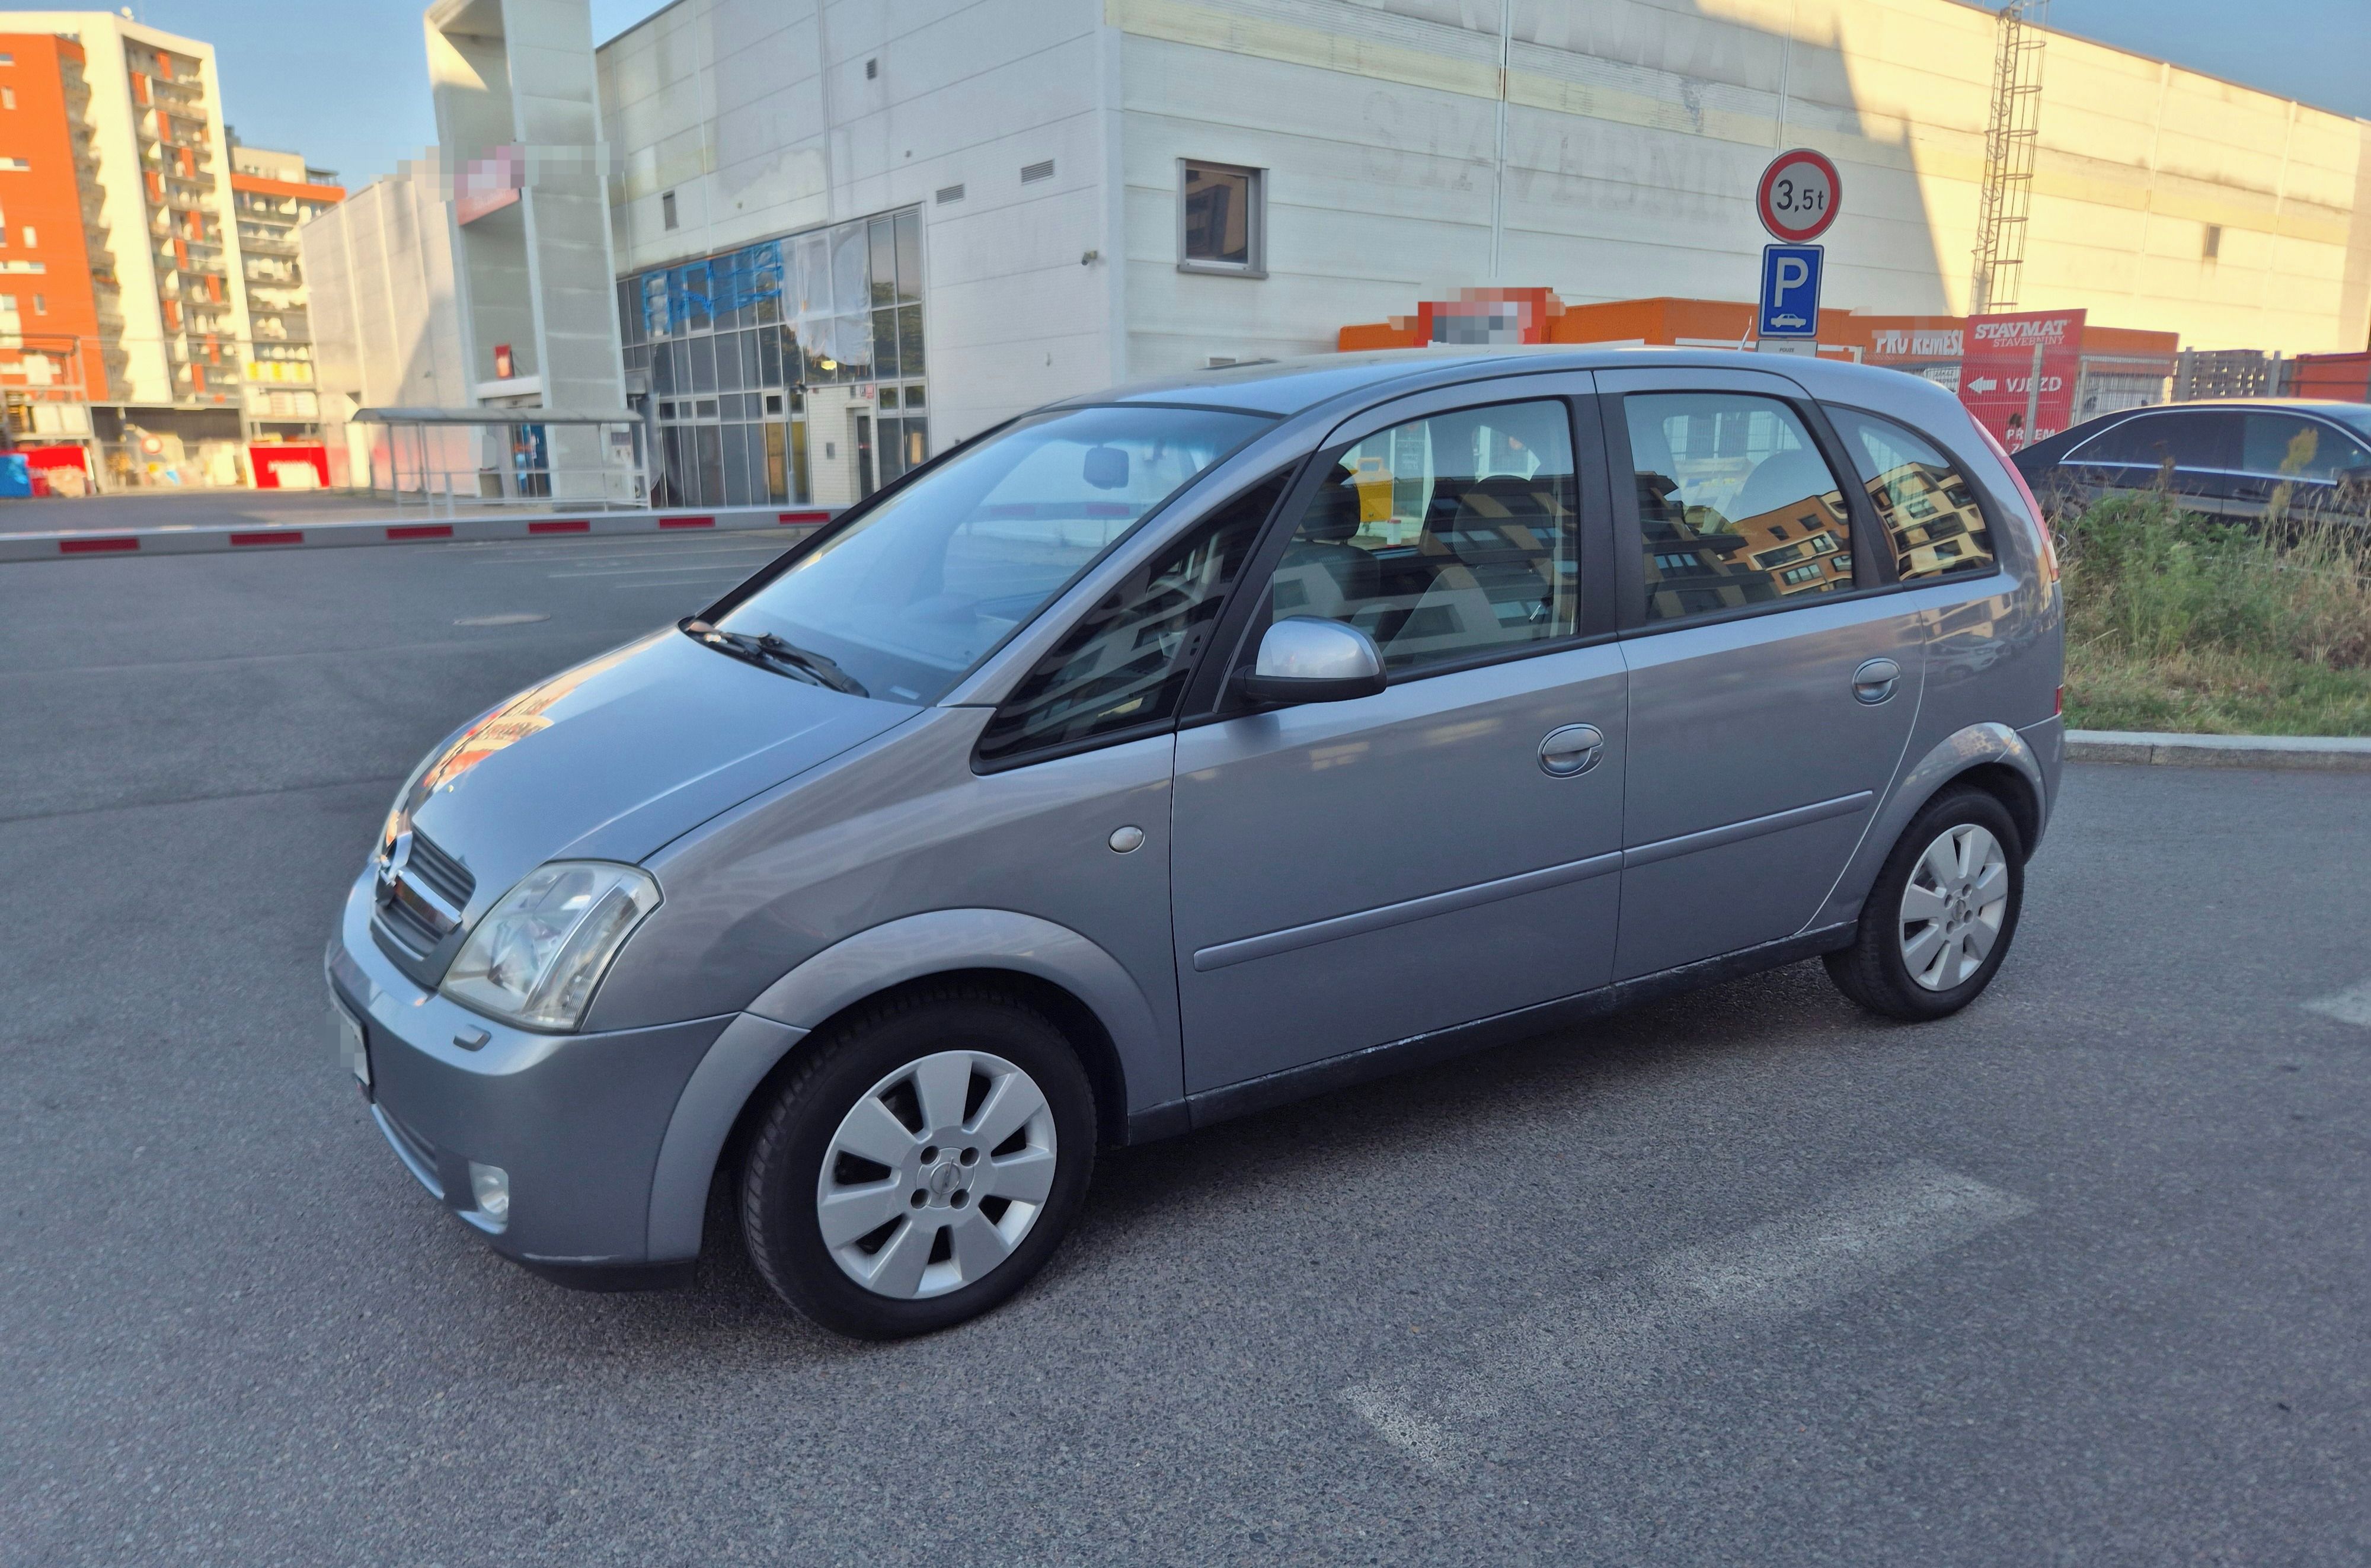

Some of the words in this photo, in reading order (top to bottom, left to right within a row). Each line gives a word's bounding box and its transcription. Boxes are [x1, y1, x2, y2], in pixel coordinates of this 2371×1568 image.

[1774, 257, 1808, 307] P
[1974, 319, 2068, 340] STAVMAT
[1993, 335, 2065, 348] STAVEBNINY
